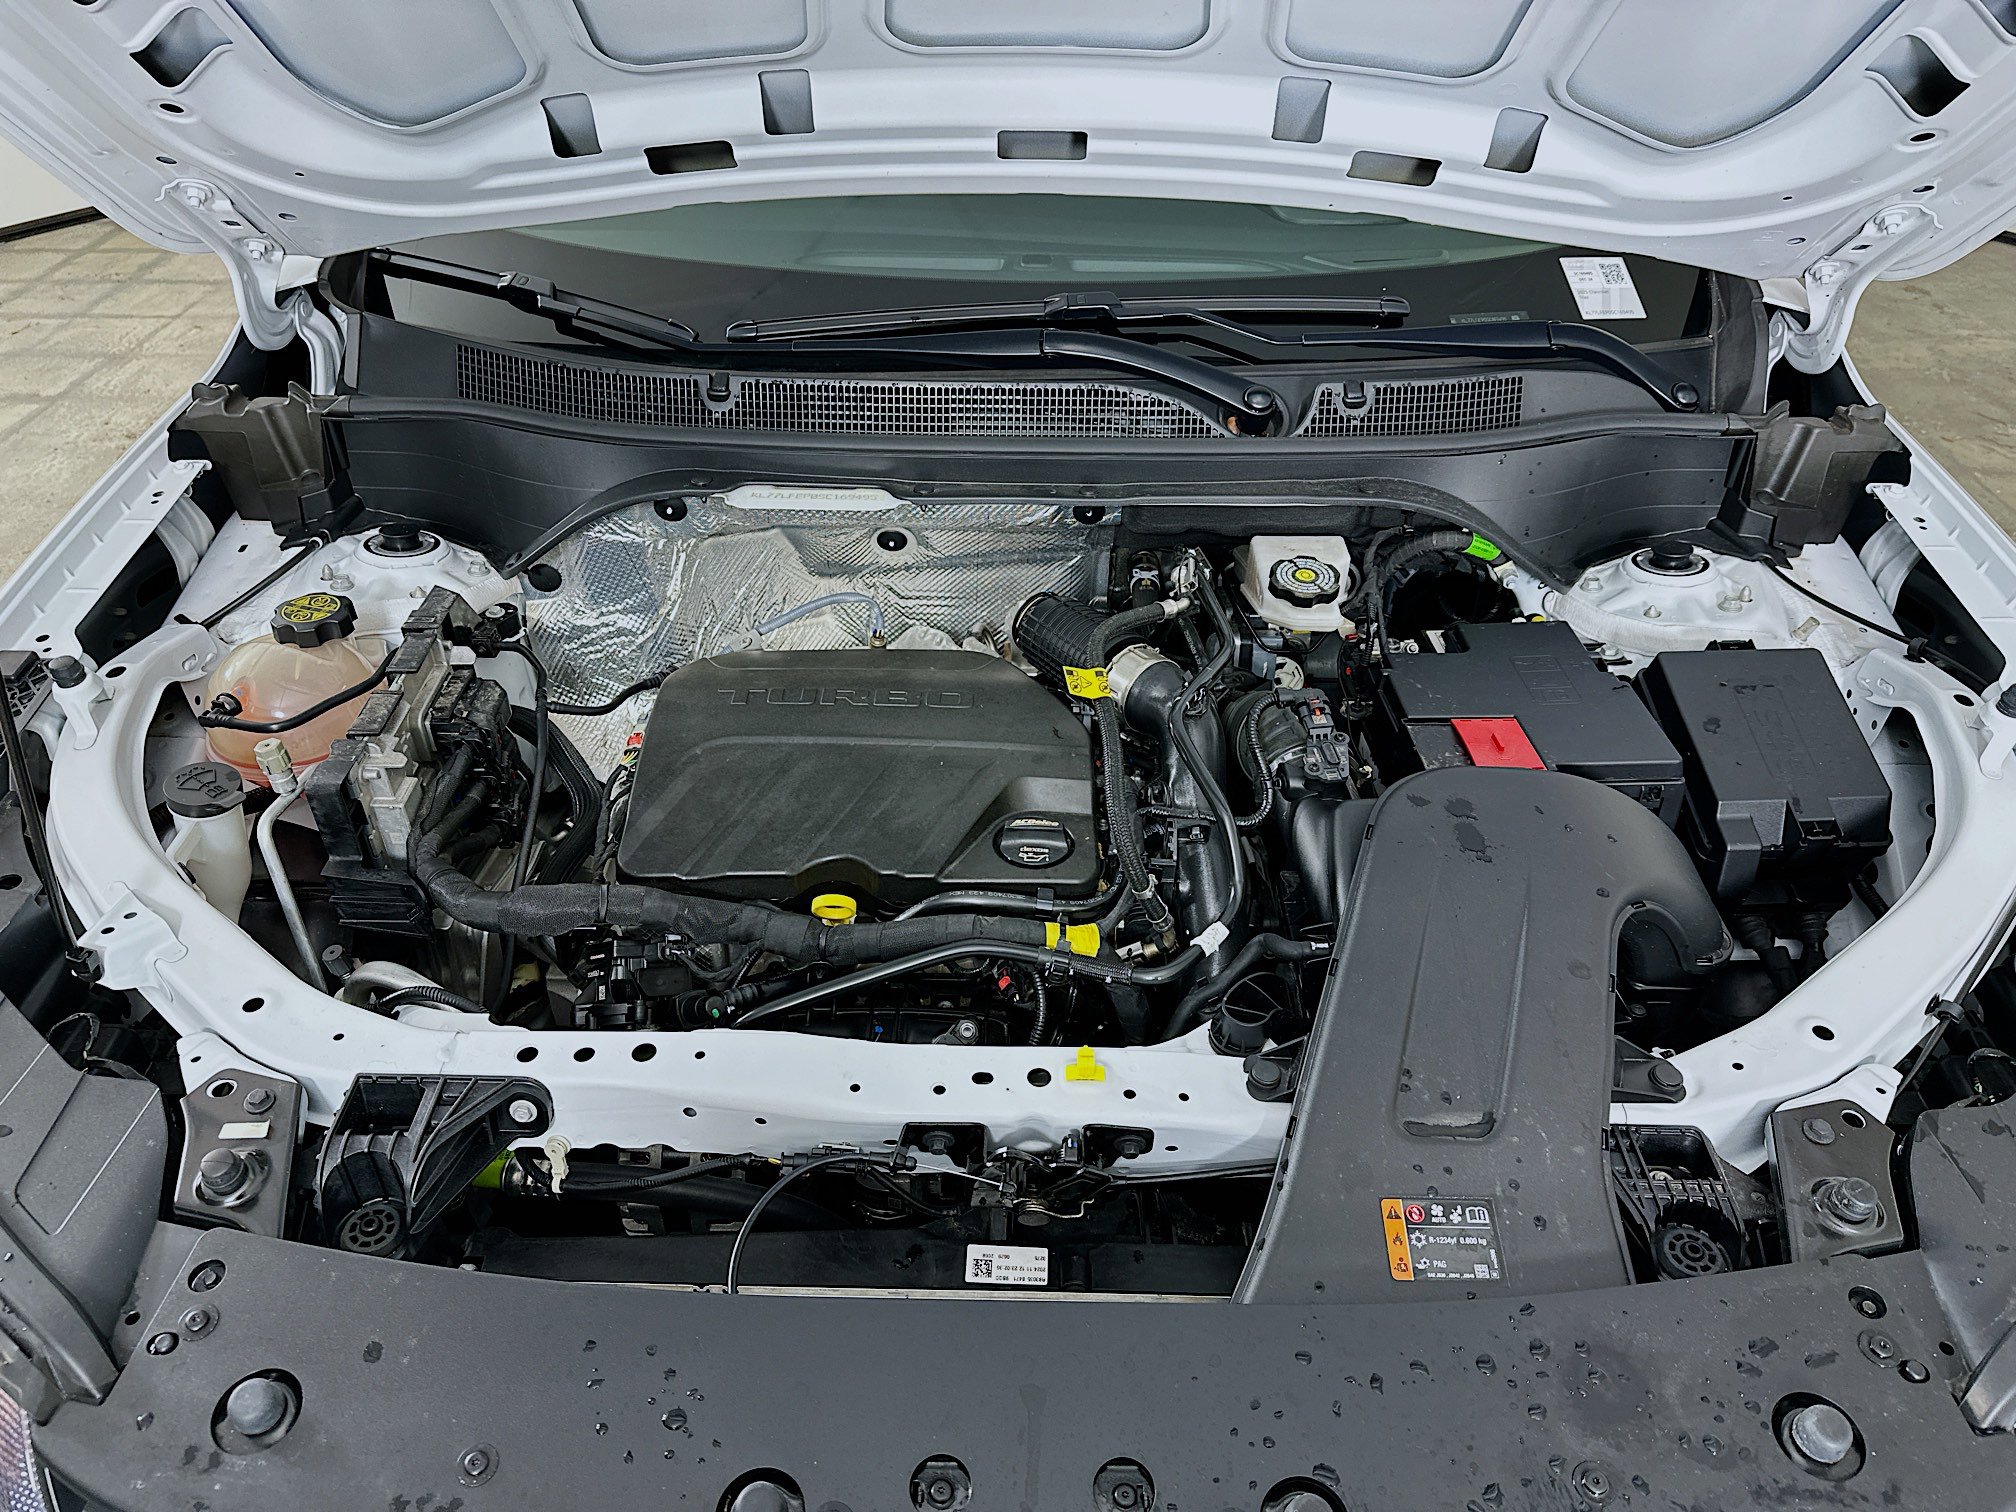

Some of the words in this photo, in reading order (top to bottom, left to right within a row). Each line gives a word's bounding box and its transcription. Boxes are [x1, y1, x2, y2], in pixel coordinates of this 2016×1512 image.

[717, 688, 975, 708] TURBO
[1009, 818, 1060, 827] ACDelco
[1019, 845, 1050, 853] dexos
[1432, 1260, 1447, 1269] PAG
